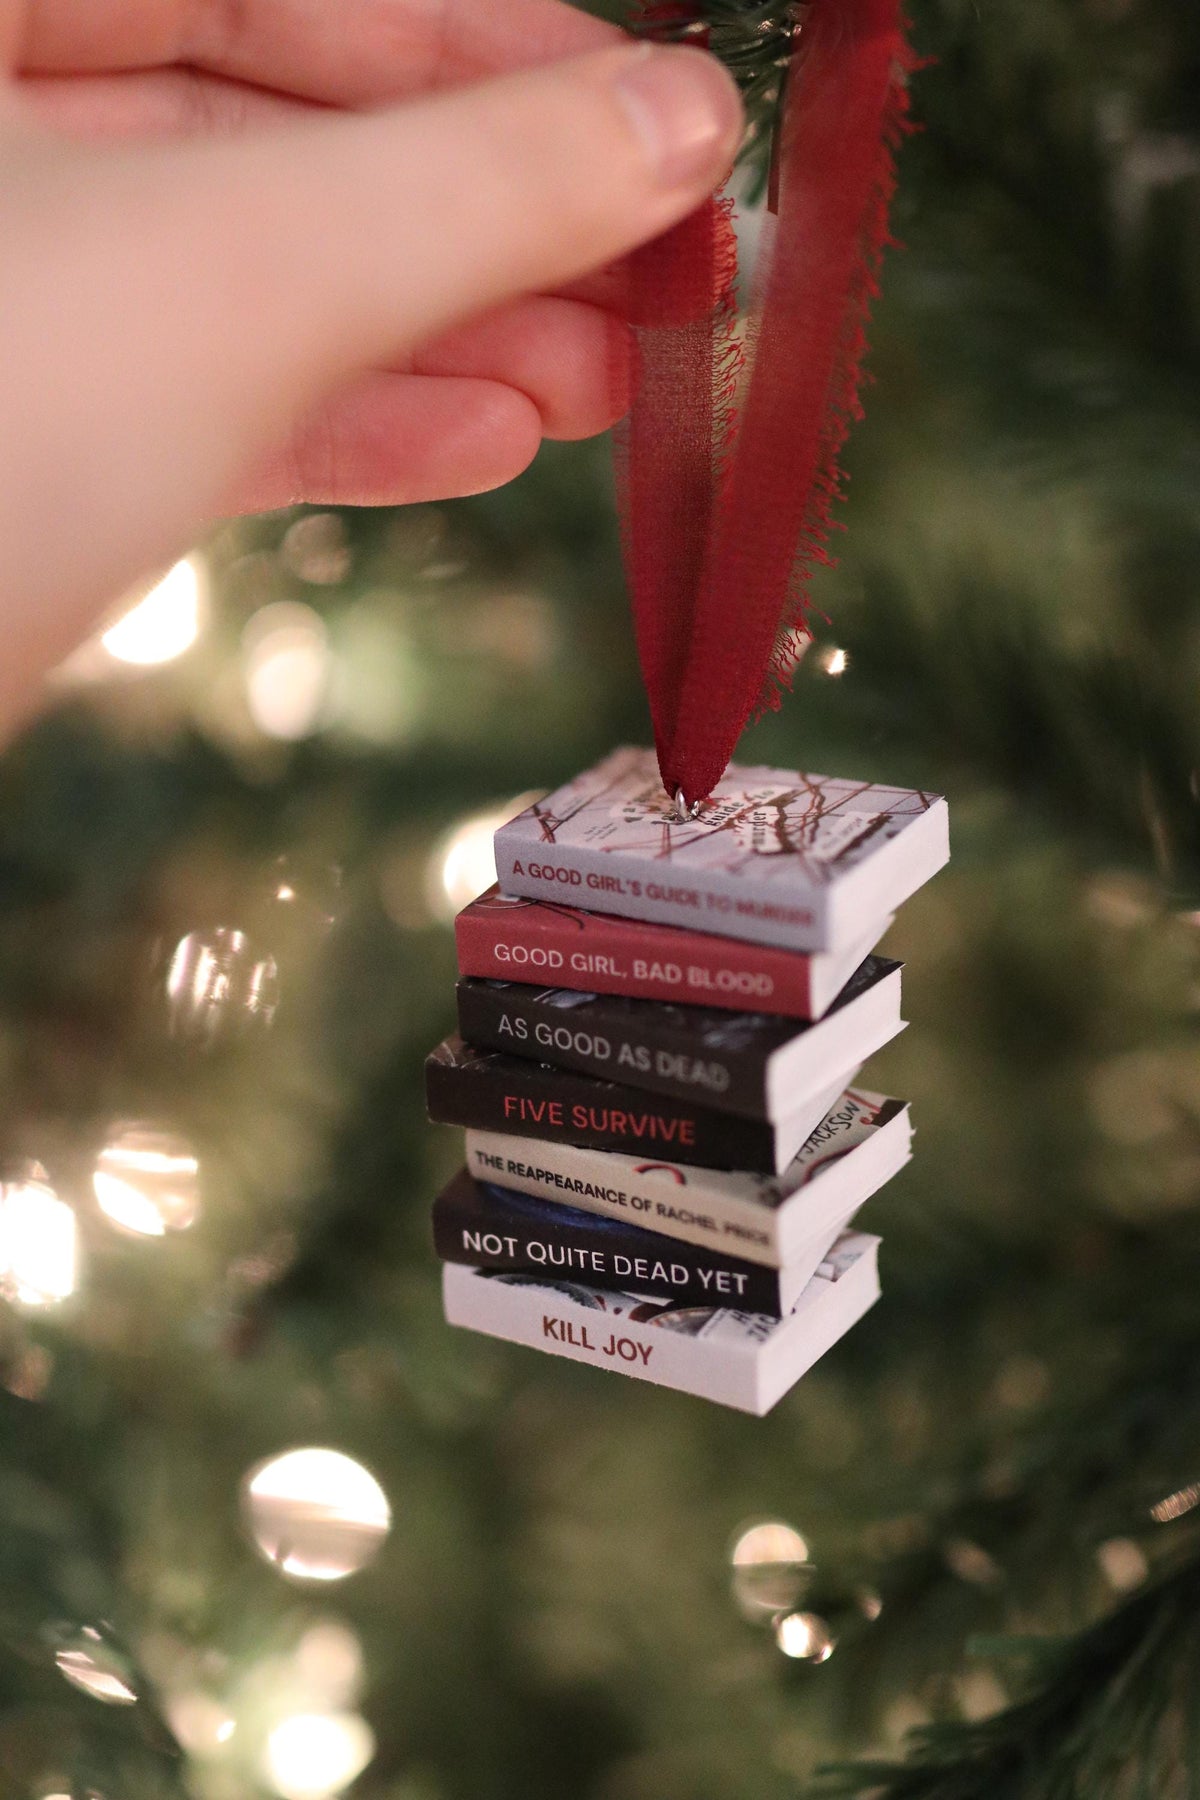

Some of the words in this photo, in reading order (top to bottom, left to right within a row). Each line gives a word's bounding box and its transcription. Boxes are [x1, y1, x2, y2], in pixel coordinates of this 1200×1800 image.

[512, 860, 525, 876] A
[529, 864, 582, 886] GOOD
[586, 873, 642, 897] GIRL'S
[646, 884, 699, 908] GUIDE
[707, 891, 731, 913] TO
[494, 943, 564, 968] GOOD
[570, 953, 627, 979] GIRL,
[633, 960, 682, 985] BAD
[687, 966, 774, 997] BLOOD
[498, 1013, 528, 1039] AS
[534, 1022, 612, 1060] GOOD
[618, 1044, 652, 1072] AS
[656, 1053, 730, 1090] DEAD
[504, 1096, 563, 1126] FIVE
[572, 1107, 696, 1145] SURVIVE
[805, 1100, 861, 1154] JACKSON
[475, 1150, 504, 1172] THE
[507, 1160, 628, 1206] REAPPEARANCE
[630, 1194, 653, 1213] OF
[656, 1202, 719, 1233] RACHEL
[462, 1229, 518, 1258] NOT
[526, 1241, 606, 1272] QUITE
[614, 1256, 689, 1286] DEAD
[697, 1267, 748, 1296] YET
[543, 1315, 596, 1351] KILL
[603, 1334, 654, 1367] JOY
